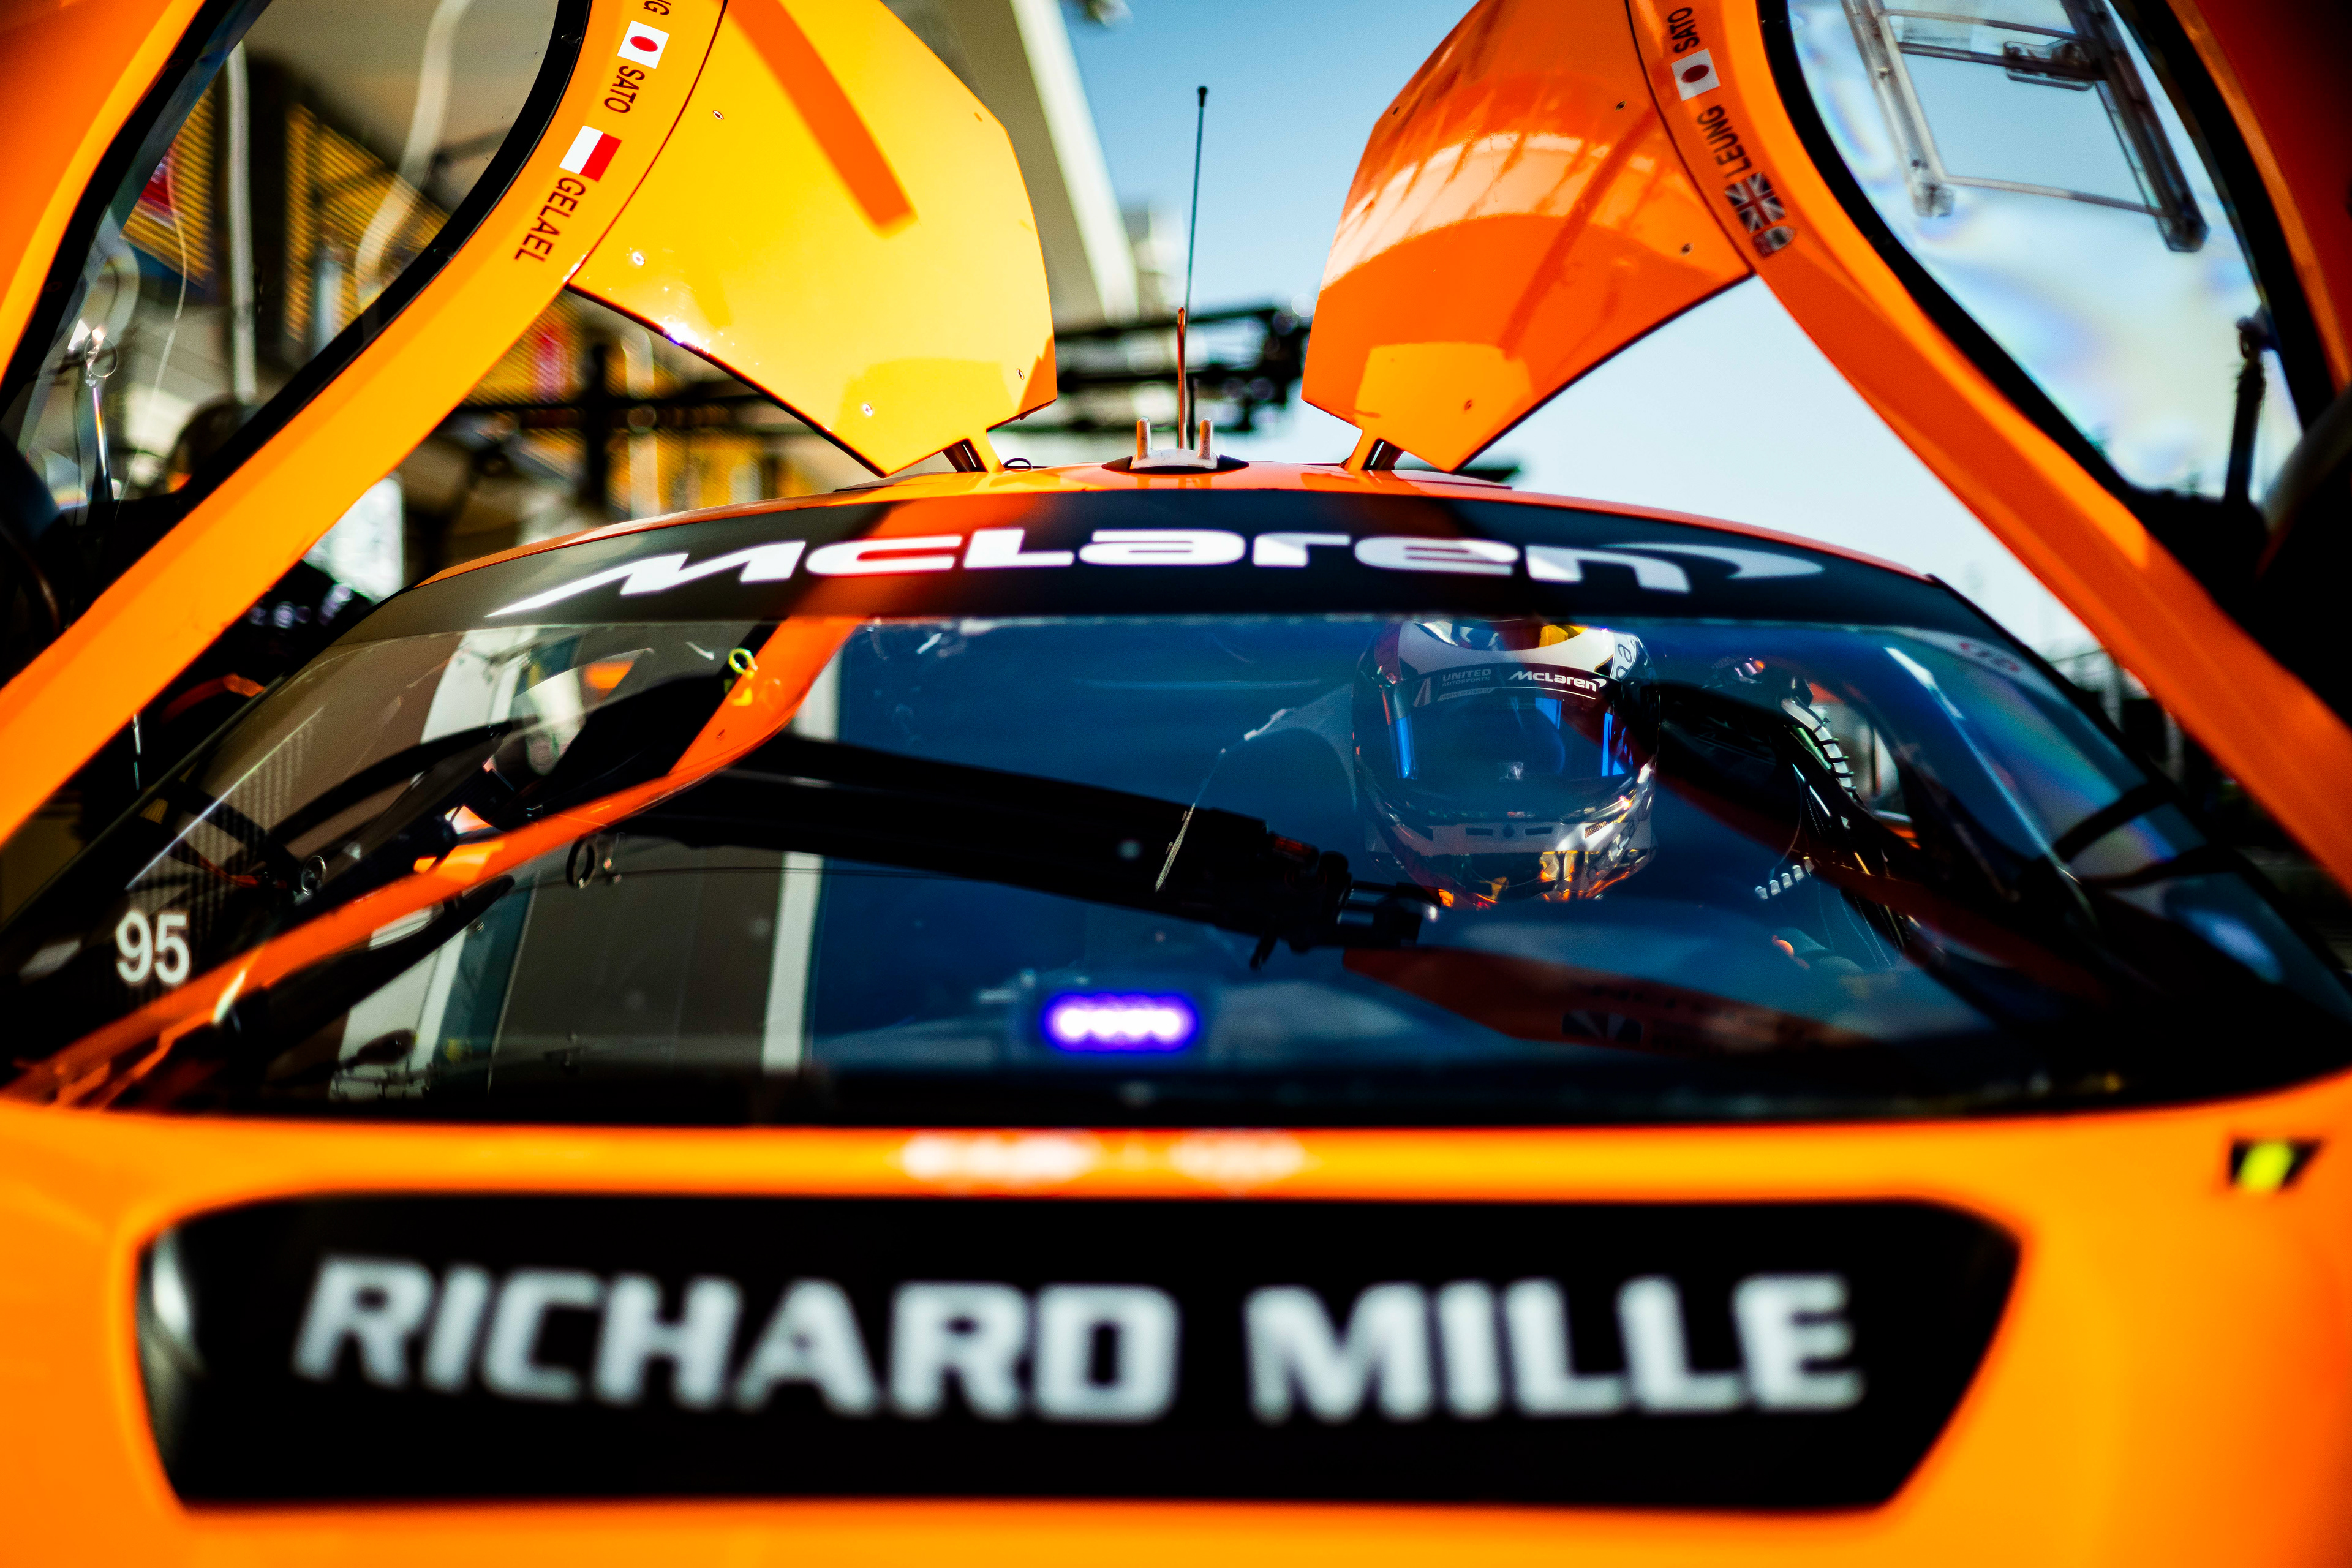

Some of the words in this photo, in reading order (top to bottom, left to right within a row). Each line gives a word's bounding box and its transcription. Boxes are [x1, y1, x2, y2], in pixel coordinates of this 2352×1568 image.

[643, 0, 671, 15] G
[1667, 7, 1700, 54] SATO
[603, 65, 646, 114] SATO
[1697, 104, 1752, 178] LEUNG
[513, 177, 587, 263] GELAEL
[485, 528, 1694, 617] McLaren
[1441, 677, 1490, 687] AUTOSPORTS
[1442, 669, 1491, 682] UNITED
[1508, 671, 1597, 692] McLaren
[115, 909, 190, 985] 95
[299, 1257, 1178, 1421] RICHARD
[1246, 1274, 1860, 1421] MILLE
